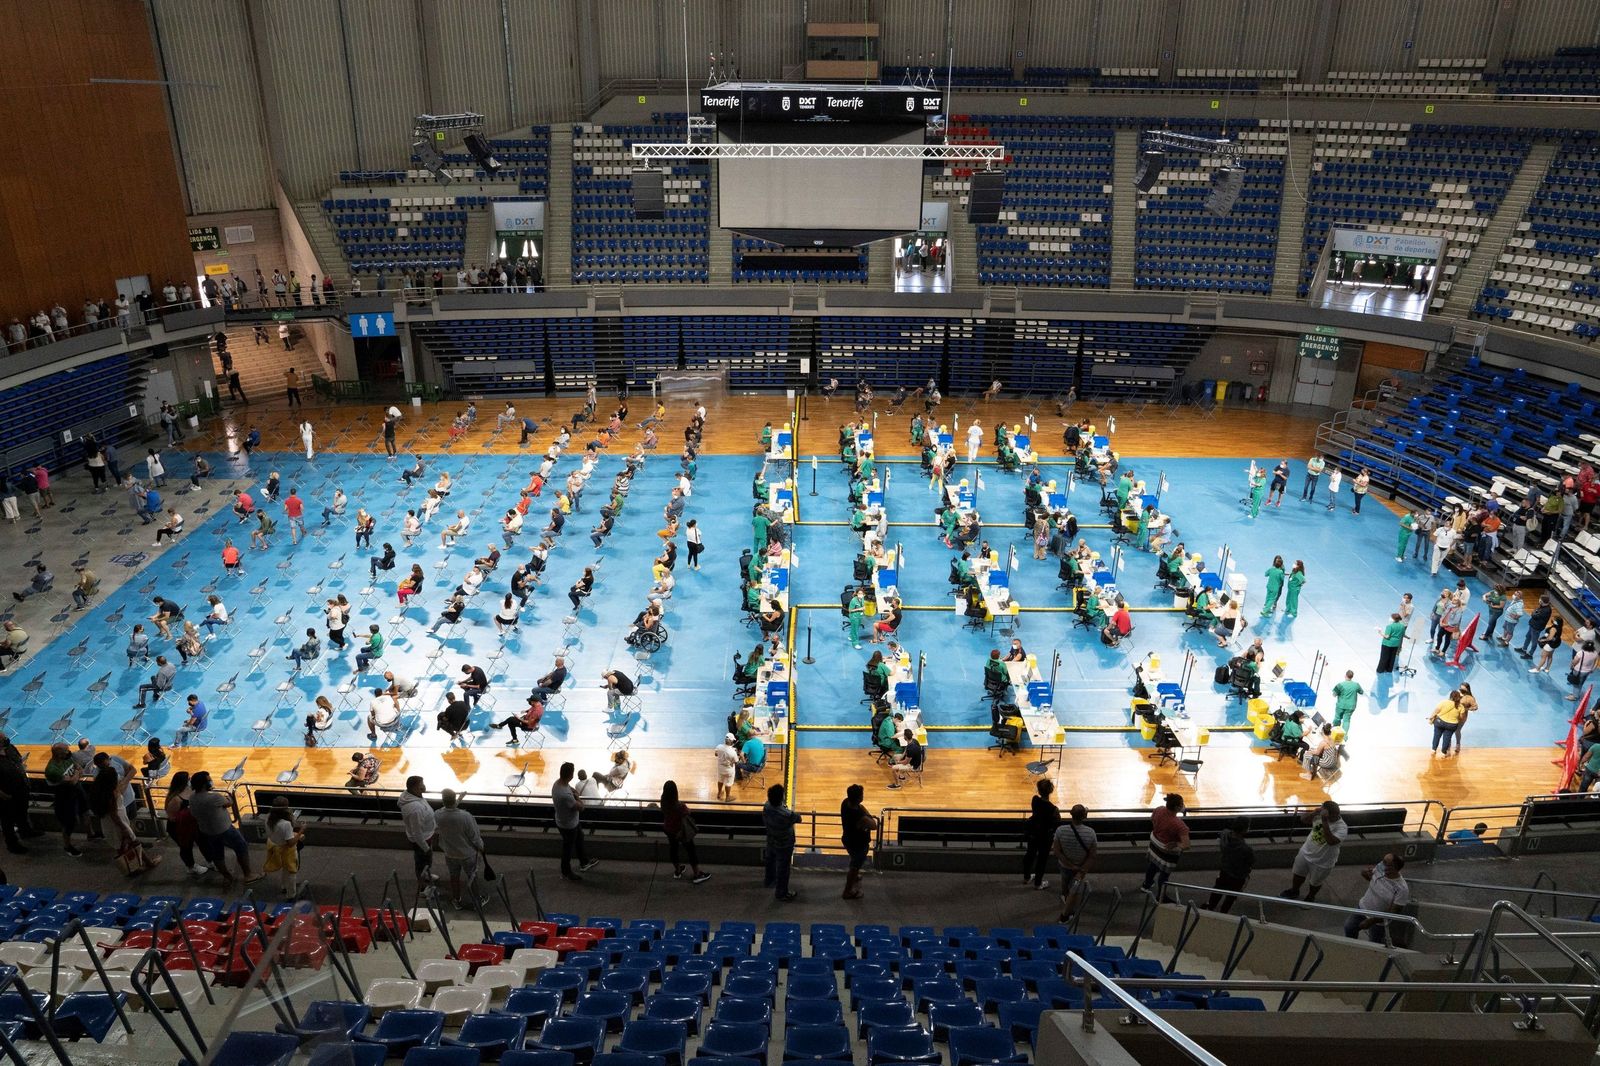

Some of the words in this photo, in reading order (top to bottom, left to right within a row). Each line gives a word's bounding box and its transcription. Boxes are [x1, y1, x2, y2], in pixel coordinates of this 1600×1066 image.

[702, 95, 740, 109] Tenerife
[798, 97, 817, 105] DXT
[826, 97, 864, 110] Tenerife
[1366, 235, 1391, 245] DXT
[1404, 245, 1436, 255] deportes
[1305, 334, 1326, 343] SALIDA
[1301, 341, 1339, 352] EMERGENCIA
